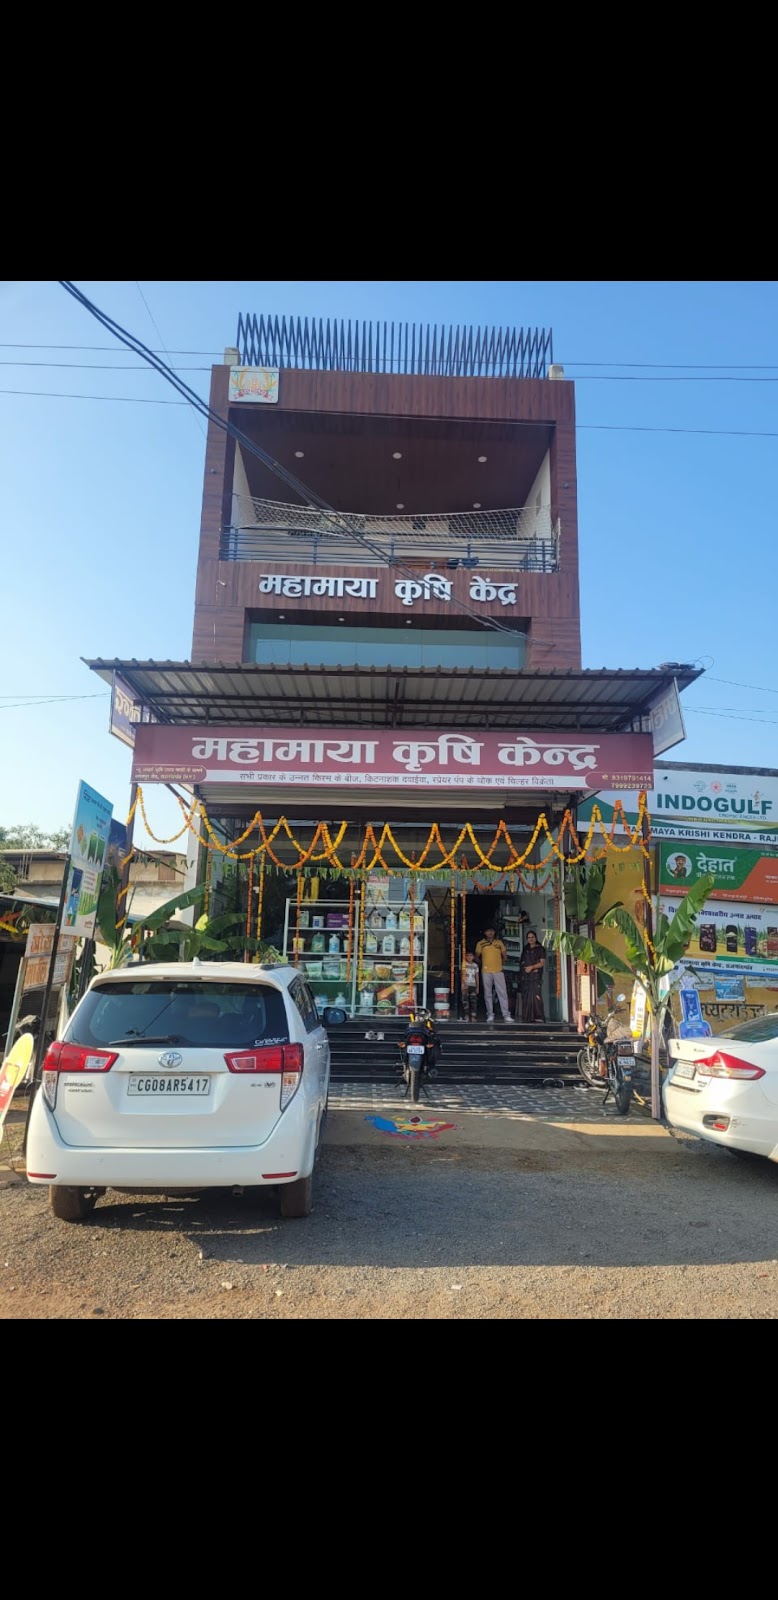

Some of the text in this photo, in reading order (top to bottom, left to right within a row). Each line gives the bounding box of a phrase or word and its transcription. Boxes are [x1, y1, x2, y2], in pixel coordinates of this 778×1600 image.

[259, 573, 519, 605] महामाया कृषि केंद्र
[192, 733, 600, 772] महामाया कृषि केन्द्र
[240, 771, 254, 780] सभी
[257, 773, 276, 781] प्रकार
[280, 773, 286, 781] के
[289, 774, 309, 782] उन्नत
[334, 773, 342, 782] के
[467, 775, 474, 784] के
[657, 793, 773, 815] INDOGULF
[678, 828, 710, 838] KRISHI
[713, 831, 751, 841] KENDRA
[759, 834, 778, 842] RAJ
[696, 852, 736, 873] देहात
[137, 1078, 209, 1092] CG08AR5417
